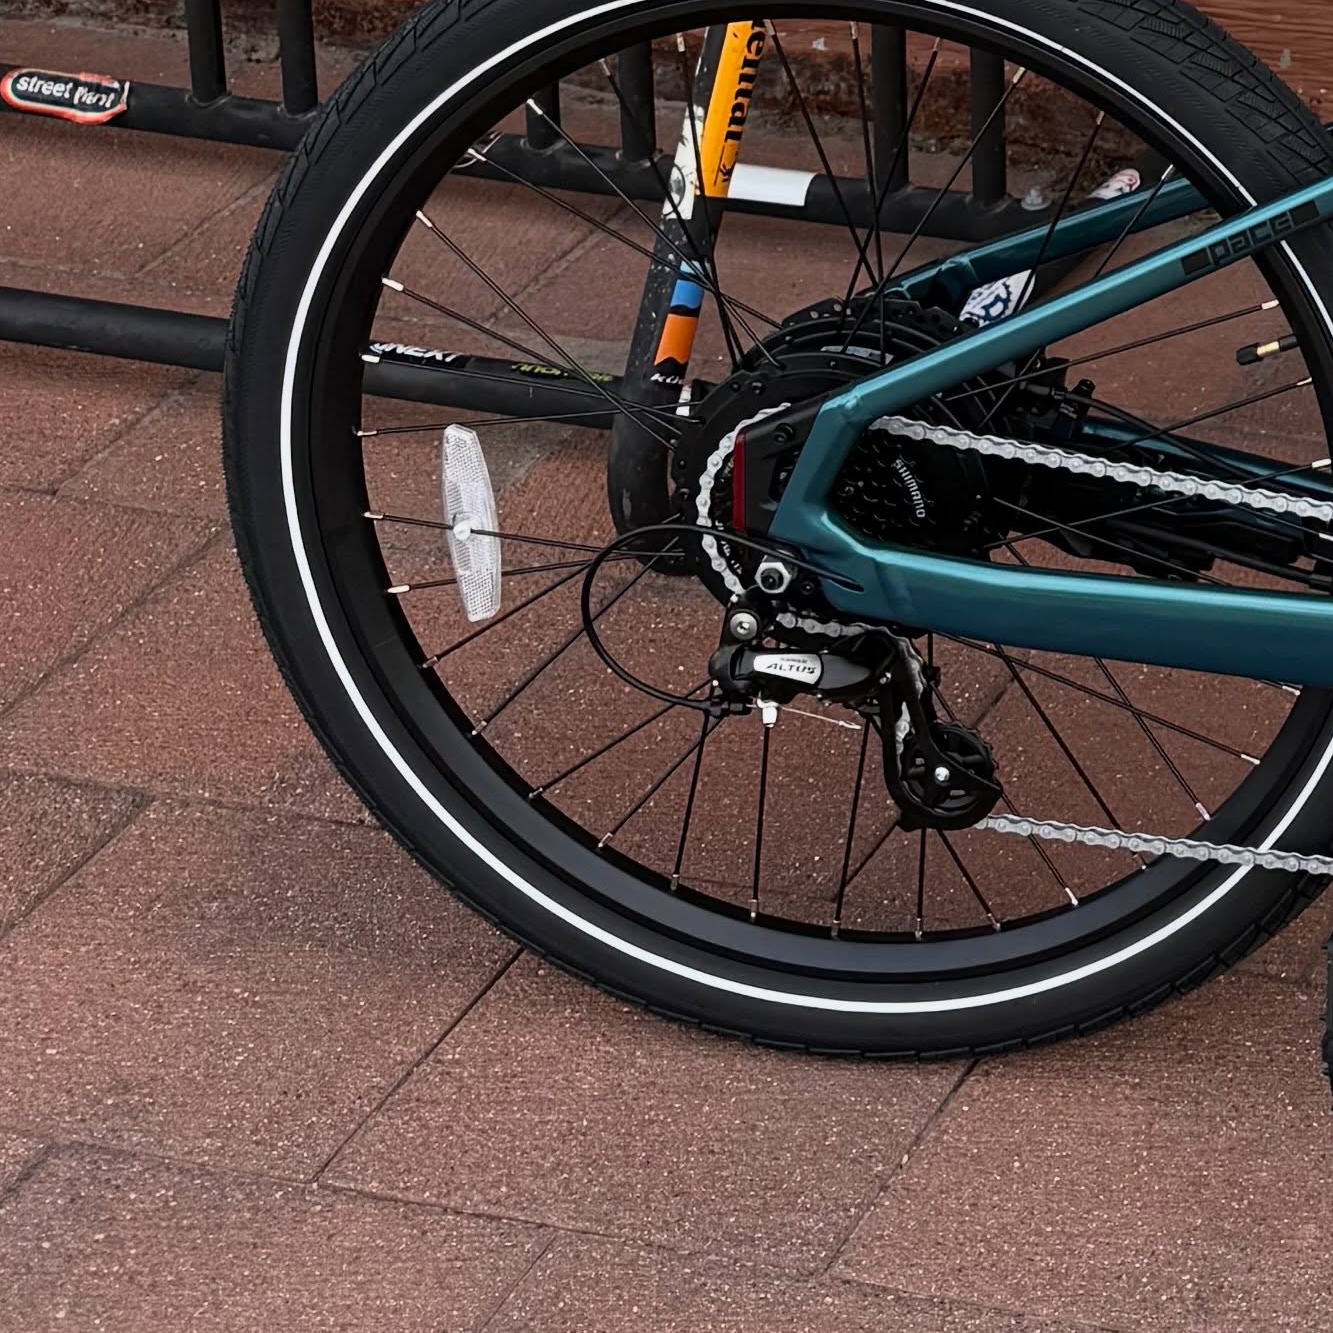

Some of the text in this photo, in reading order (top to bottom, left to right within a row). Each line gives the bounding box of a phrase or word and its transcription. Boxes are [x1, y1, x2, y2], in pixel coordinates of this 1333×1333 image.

[16, 75, 74, 99] street
[894, 458, 926, 518] SHIMANO
[766, 663, 817, 675] ALTUS
